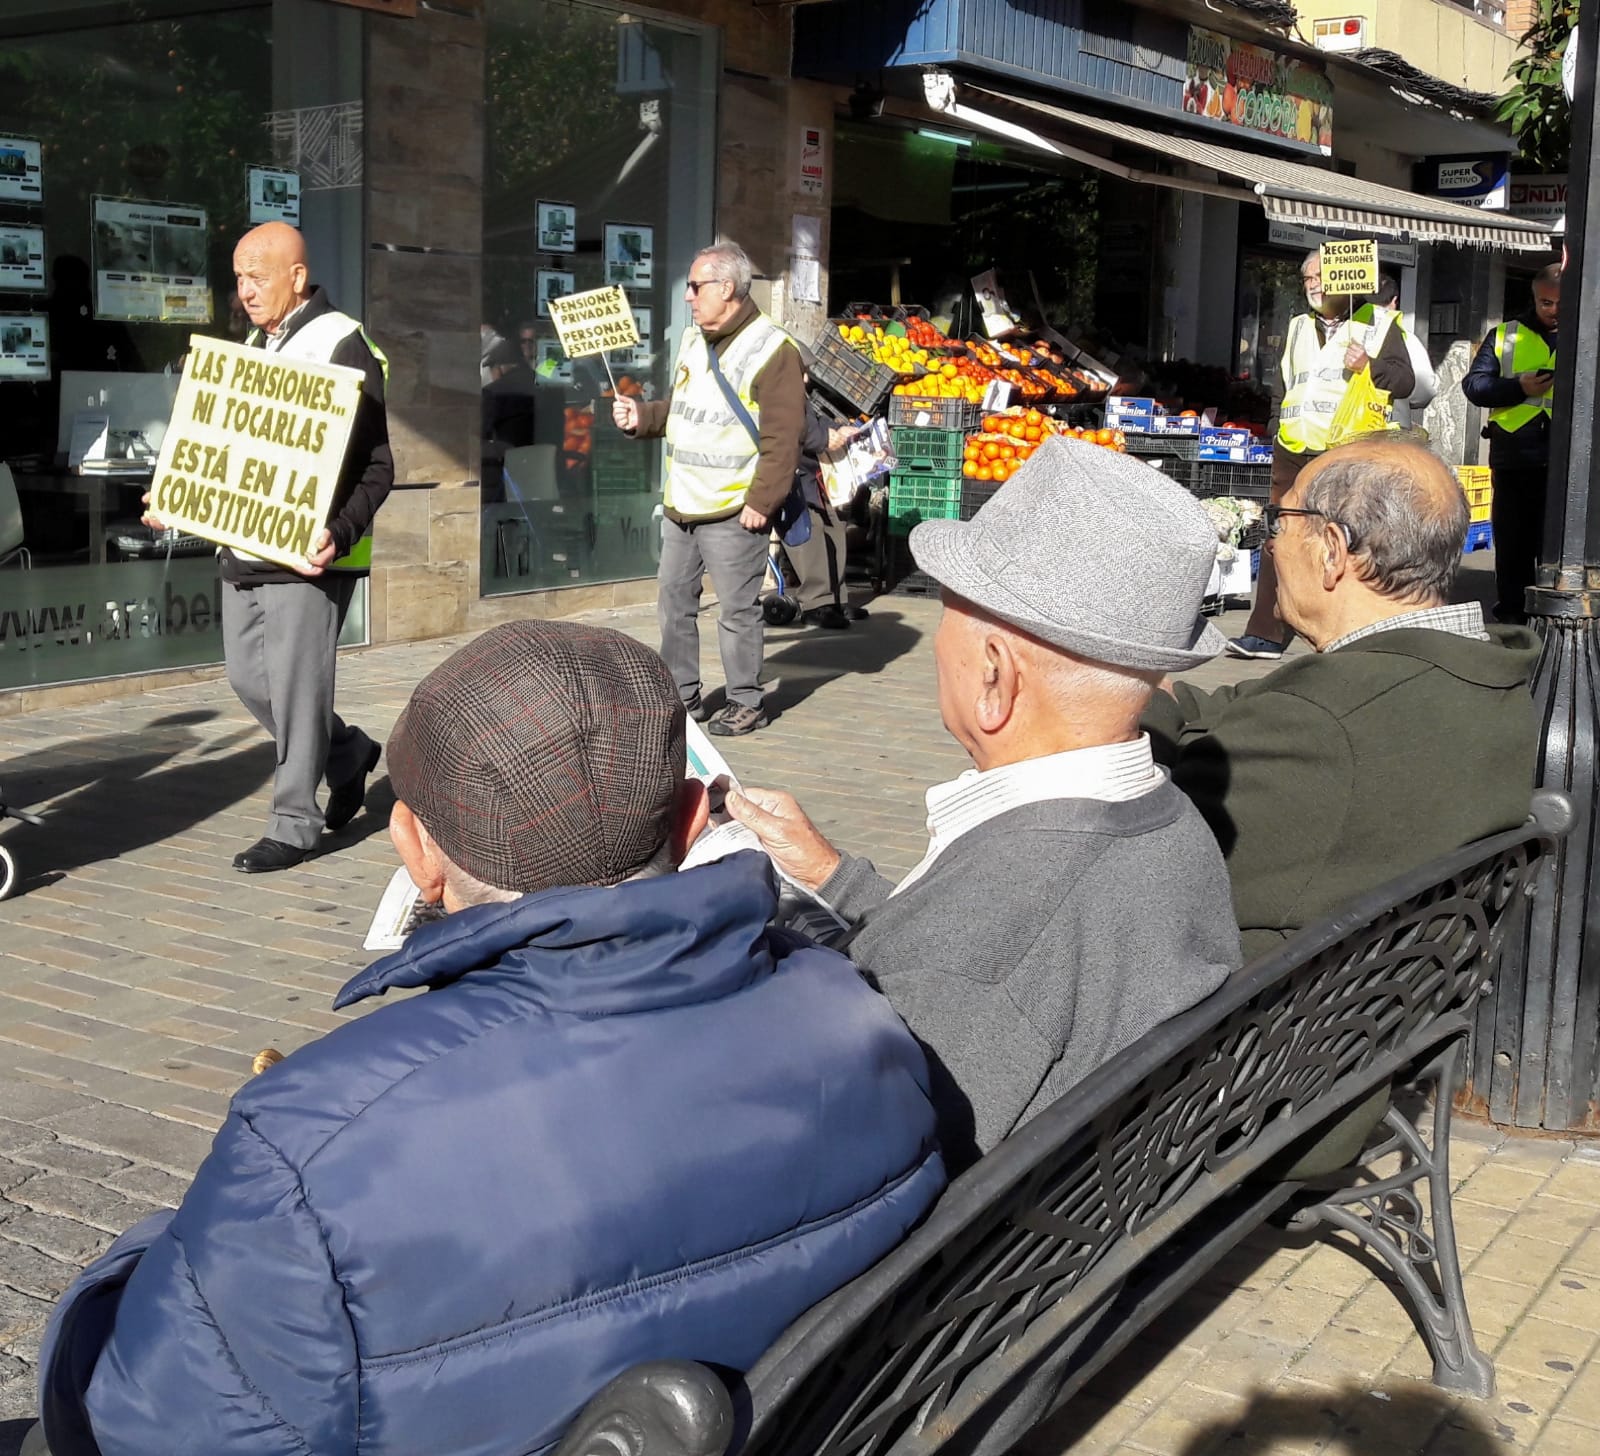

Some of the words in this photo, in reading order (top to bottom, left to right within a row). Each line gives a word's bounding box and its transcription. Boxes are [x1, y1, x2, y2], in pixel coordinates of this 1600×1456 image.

[1440, 176, 1478, 185] EFECTIVO
[1441, 168, 1471, 177] SUPER
[1323, 257, 1332, 265] DE
[1335, 255, 1373, 264] PENSIONES
[1324, 244, 1372, 255] RECORTE
[1329, 269, 1366, 281] OFICIO
[1324, 284, 1332, 292] DE
[1336, 282, 1375, 291] LADRONES
[552, 289, 620, 313] PENSIONES
[561, 304, 621, 325] PRIVADAS
[563, 319, 631, 343] PERSONAS
[568, 332, 635, 354] ESTAFADAS
[190, 349, 227, 384] LAS
[230, 358, 346, 417] PENSIONES...
[192, 390, 217, 425] NI
[222, 398, 328, 454] TOCARLAS
[170, 439, 230, 484] ESTÁ
[238, 458, 278, 496] EN
[284, 470, 319, 510] LA
